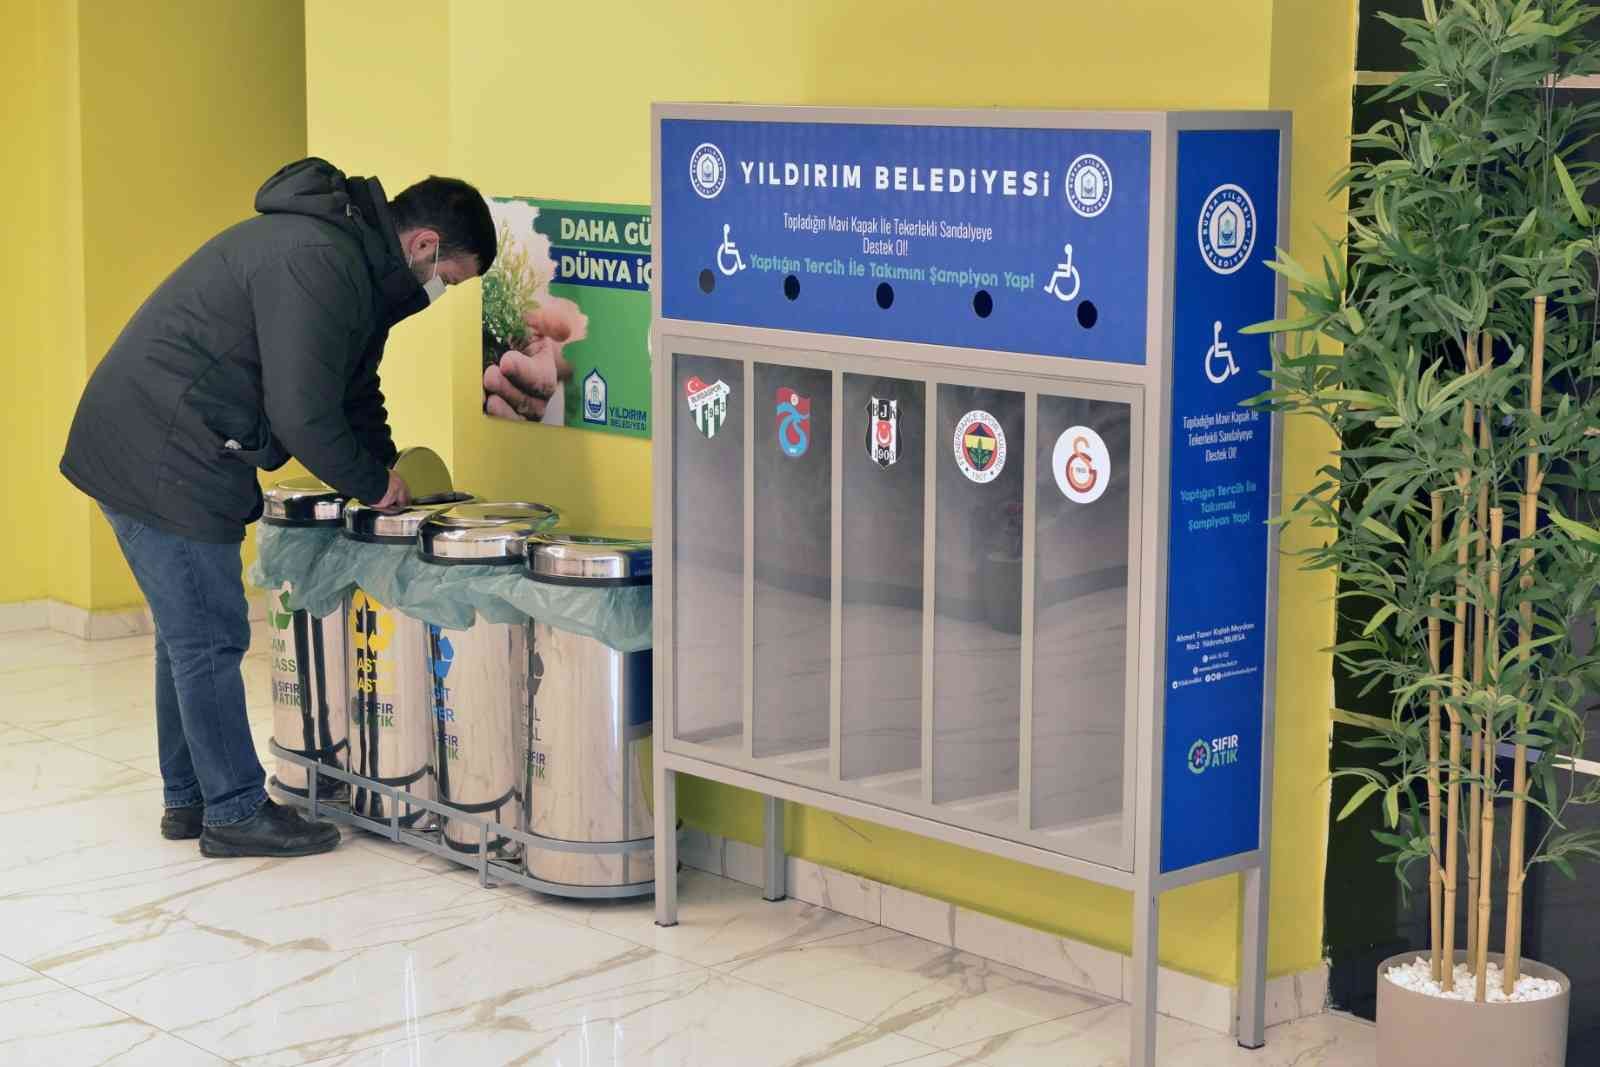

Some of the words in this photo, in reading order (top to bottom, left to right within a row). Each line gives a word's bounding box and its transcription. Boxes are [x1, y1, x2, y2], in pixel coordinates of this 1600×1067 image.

[740, 160, 861, 189] YILDIRIM
[875, 165, 1050, 198] BELEDİYESİ
[561, 217, 620, 244] DAHA
[783, 211, 826, 234] Topladığın
[828, 215, 849, 232] Mavi
[851, 215, 878, 235] Kapak
[894, 217, 938, 239] Tekerlekli
[940, 220, 993, 242] Sandalyeye
[863, 237, 894, 256] Destek
[896, 239, 909, 257] Ol!
[561, 250, 632, 284] DÜNYA
[750, 253, 801, 274] Yaptığın
[803, 257, 845, 275] Tercih
[848, 256, 865, 277] İle
[869, 261, 925, 281] Takımını
[929, 264, 998, 288] Şampiyon
[1004, 271, 1035, 292] Yap!
[872, 403, 896, 420] BJK
[1211, 734, 1239, 752] SIFIR
[1212, 749, 1238, 767] ATIK
